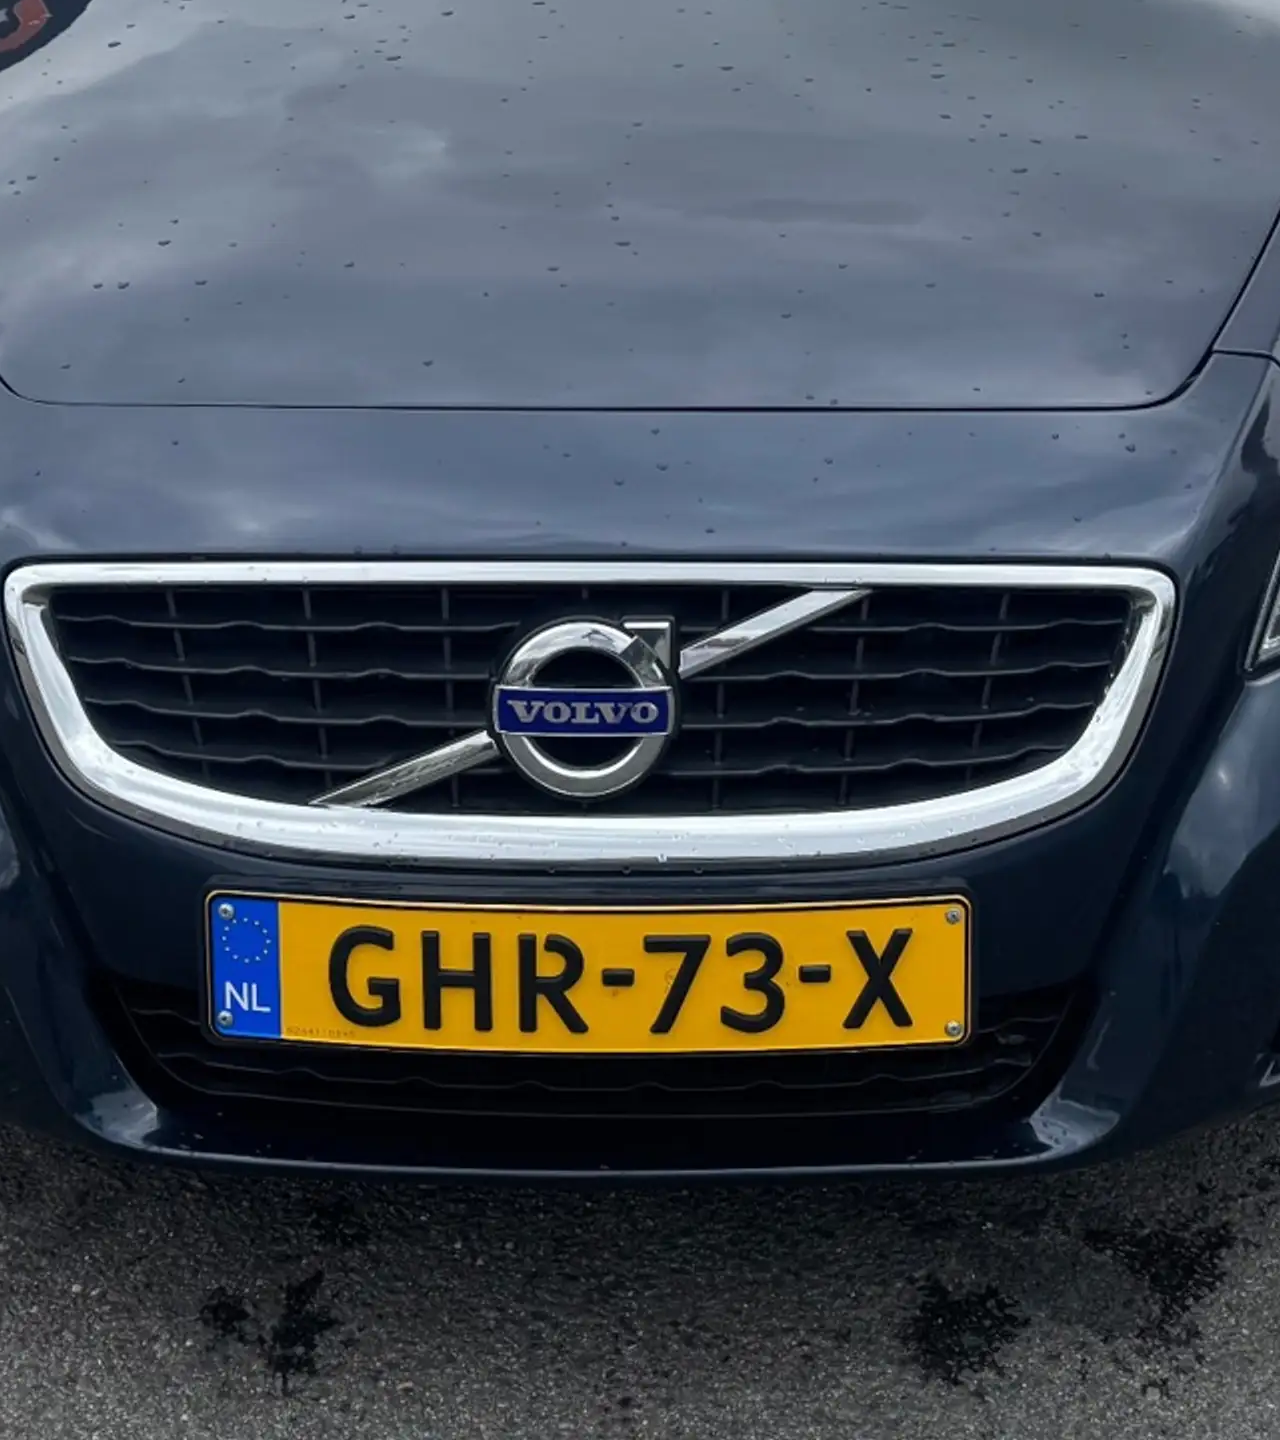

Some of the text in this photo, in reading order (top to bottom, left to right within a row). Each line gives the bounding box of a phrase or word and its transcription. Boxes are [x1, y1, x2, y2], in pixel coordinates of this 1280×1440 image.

[507, 698, 660, 726] VOLVO
[327, 924, 915, 1035] GHR-73-X
[224, 980, 271, 1013] NL
